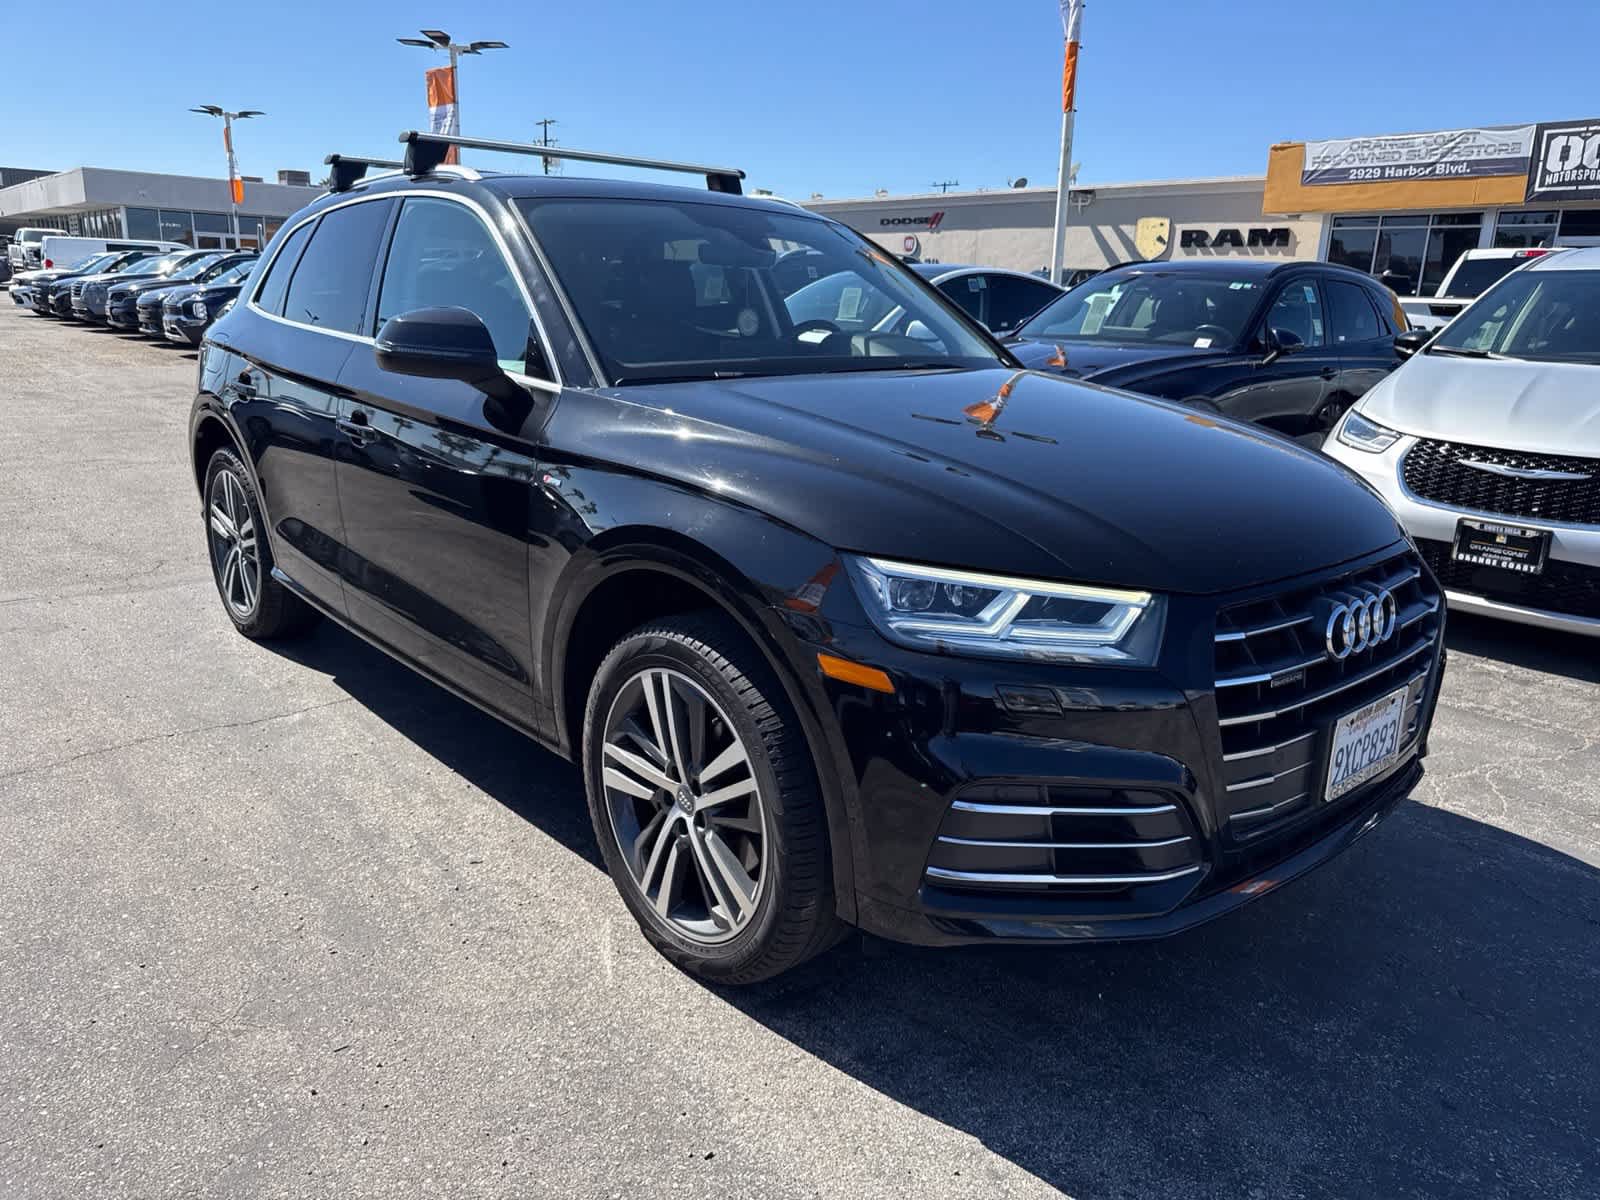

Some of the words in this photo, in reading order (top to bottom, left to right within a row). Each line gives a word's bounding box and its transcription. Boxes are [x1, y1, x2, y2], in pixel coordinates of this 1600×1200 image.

[1348, 167, 1381, 180] 2929
[1384, 164, 1432, 178] Harbor
[1435, 162, 1471, 174] Blvd.
[1180, 228, 1290, 248] RAM
[1458, 553, 1498, 567] ORANGE
[1501, 561, 1536, 573] COAST
[1332, 720, 1397, 786] 9XCP893
